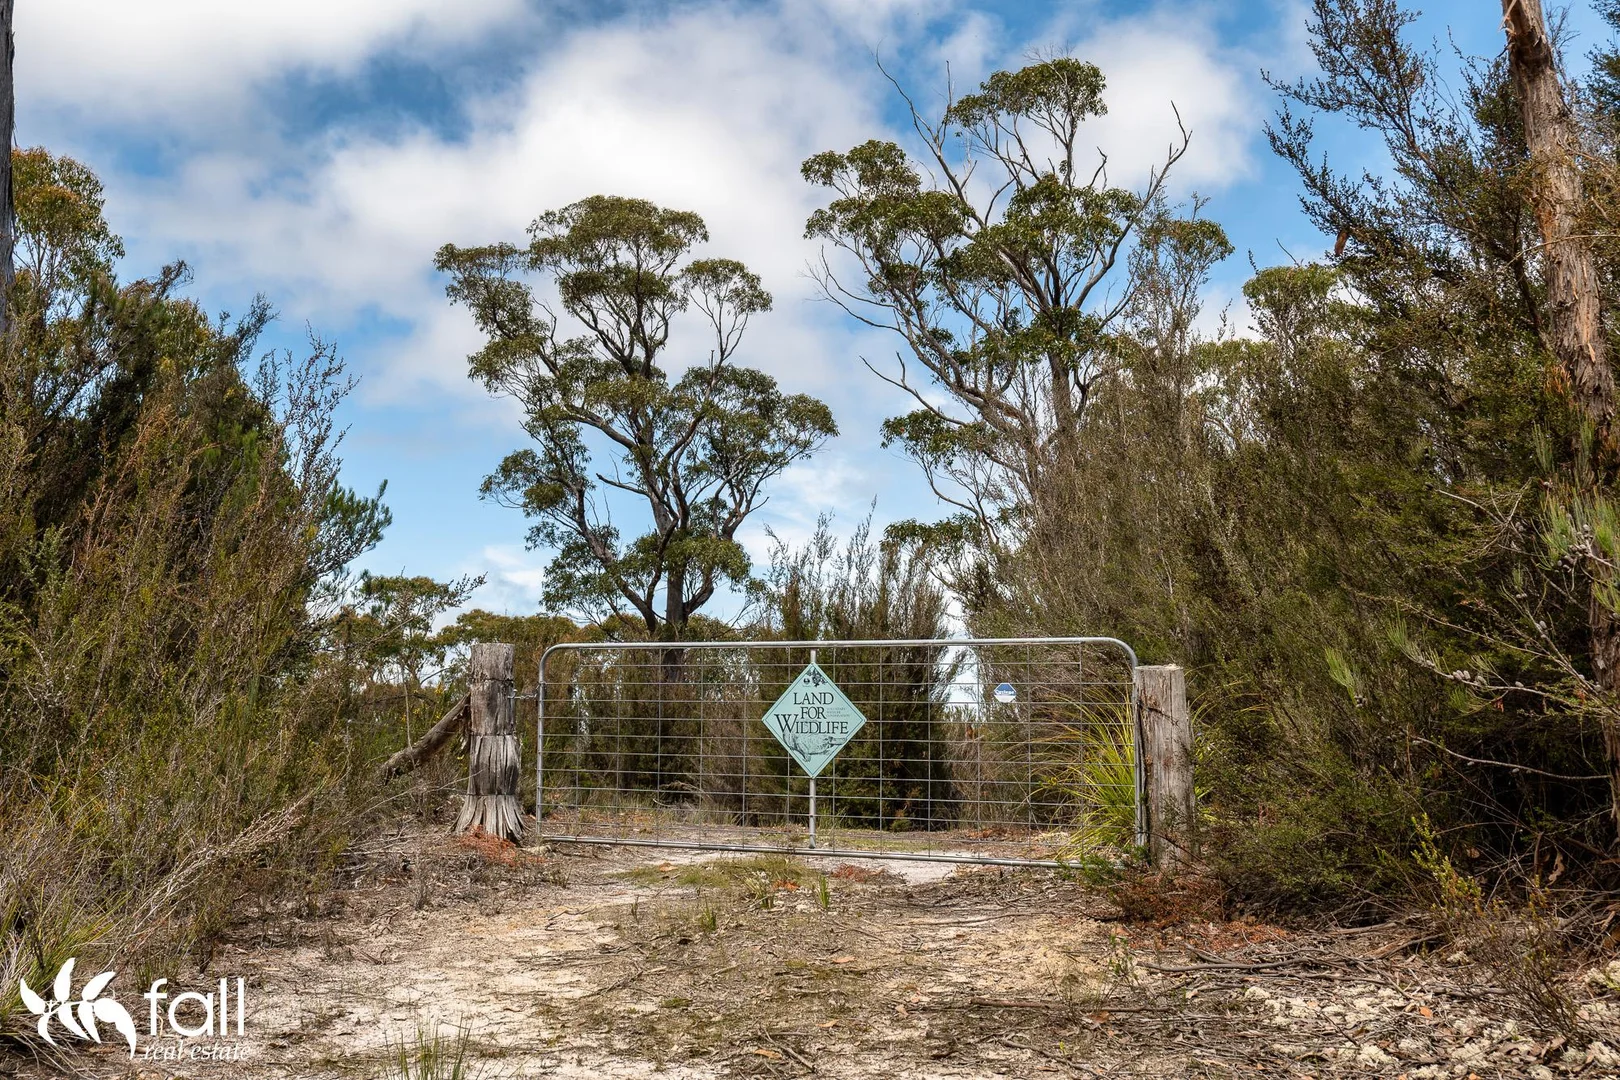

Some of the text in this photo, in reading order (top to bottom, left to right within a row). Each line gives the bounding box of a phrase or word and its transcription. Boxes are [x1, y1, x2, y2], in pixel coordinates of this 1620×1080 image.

[793, 692, 834, 705] LAND
[800, 706, 827, 719] FOR
[774, 713, 849, 734] WILDLIFE
